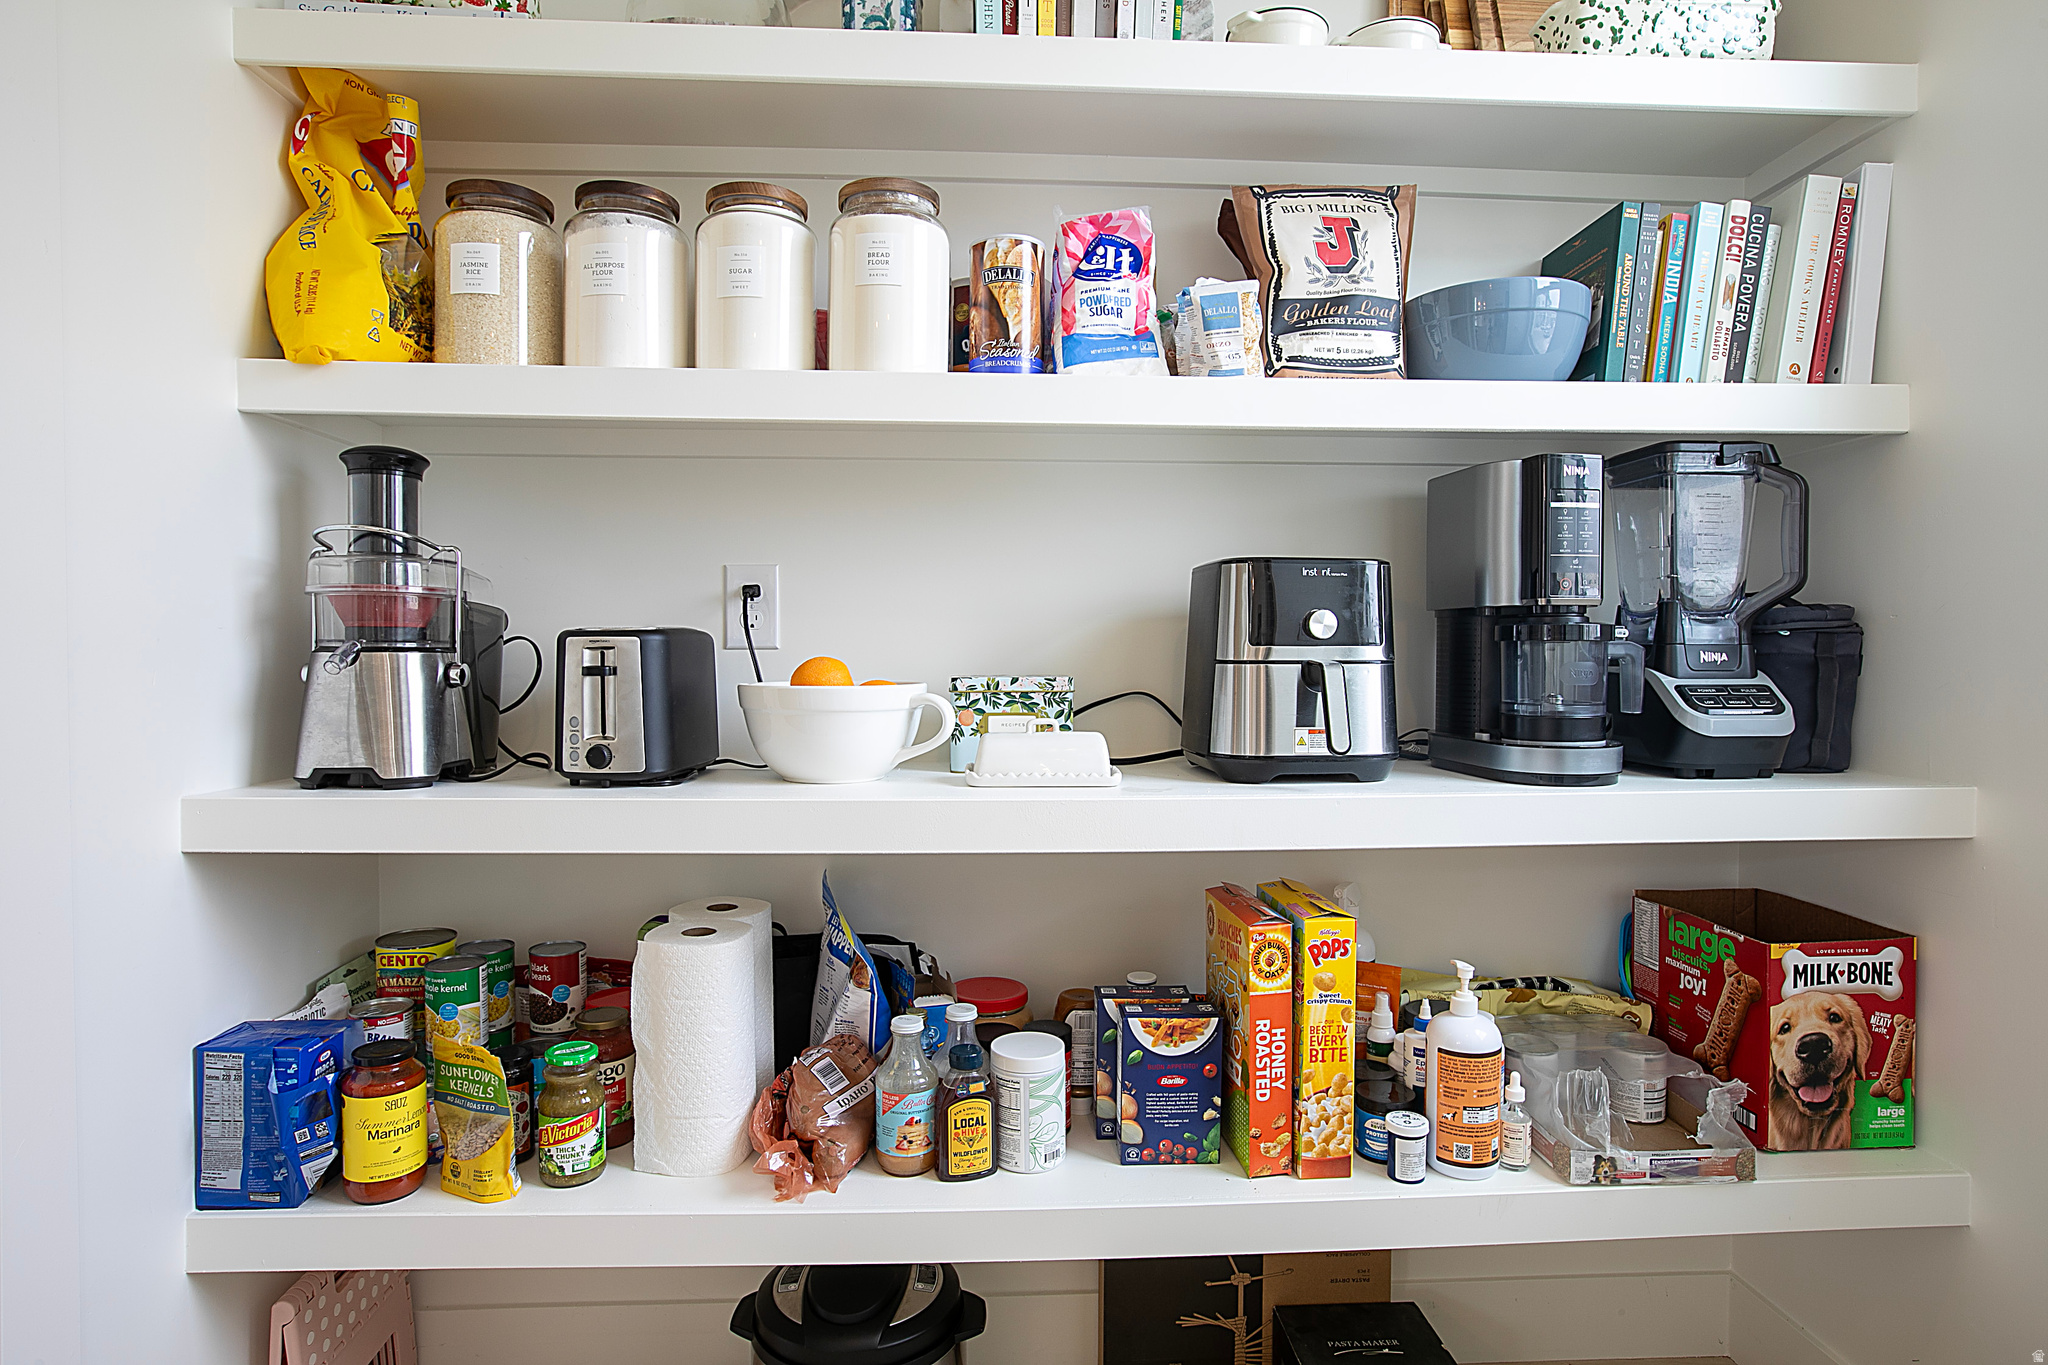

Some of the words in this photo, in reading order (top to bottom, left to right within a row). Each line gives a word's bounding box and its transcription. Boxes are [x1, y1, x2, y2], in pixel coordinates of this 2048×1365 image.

[344, 78, 365, 92] NON
[1280, 204, 1306, 214] BIG
[1308, 205, 1314, 214] J
[1317, 204, 1378, 214] MILLING
[1312, 214, 1360, 274] J
[1725, 215, 1747, 264] DOLCI!
[1744, 213, 1765, 269] CUCINA
[1810, 234, 1820, 254] THE
[1834, 204, 1852, 267] ROMNEY
[1698, 250, 1710, 294] FRENCH
[1760, 239, 1776, 286] BAKING
[1622, 252, 1633, 296] AROUND
[1664, 260, 1682, 304] INDIA
[1803, 258, 1816, 296] COOK'S
[1830, 269, 1838, 296] FAMILY
[1080, 287, 1110, 295] PREMIUM
[1632, 244, 1652, 349] HARVEST
[1089, 304, 1123, 318] SUGAR
[1204, 306, 1238, 317] DELALLO
[1283, 302, 1350, 324] Golden
[1354, 300, 1398, 322] Loaf
[1619, 298, 1628, 318] THE
[1734, 274, 1756, 333] POVERA
[1826, 300, 1834, 324] TABLE
[1306, 318, 1346, 327] BAKERS
[1346, 317, 1378, 326] FLOUR
[1796, 300, 1810, 343] ATELIER
[1616, 318, 1628, 348] TABLE
[1690, 314, 1701, 351] HEART
[1712, 320, 1724, 361] POLIAFITO
[1722, 326, 1730, 358] RENATO
[1748, 306, 1766, 366] HOLIDAYS
[400, 340, 413, 352] NET
[980, 339, 1040, 361] Seasoned
[1336, 346, 1342, 354] 5
[1658, 339, 1668, 374] SODHA
[1563, 464, 1590, 478] NINJA
[1700, 650, 1728, 665] NINJA
[1217, 918, 1242, 946] BUNCHES
[1252, 934, 1265, 942] Post
[1668, 914, 1736, 964] large
[379, 954, 429, 967] CENTO
[1226, 942, 1240, 964] FUN!
[1254, 943, 1267, 966] HONEY
[1268, 943, 1288, 964] BUNCHES
[1308, 938, 1351, 966] POPS
[1672, 946, 1711, 974] biscuits,
[494, 960, 514, 973] kernel
[531, 964, 549, 972] black
[532, 972, 551, 982] beans
[1264, 966, 1285, 978] OATS
[1666, 956, 1701, 977] maximum
[1792, 962, 1840, 989] MILK
[1846, 961, 1894, 986] BONE
[440, 982, 468, 992] kernel
[1310, 1025, 1332, 1034] BEST
[1336, 1025, 1348, 1034] IN
[1870, 1014, 1892, 1028] MEATY
[1872, 1025, 1888, 1034] Taste
[1309, 1034, 1348, 1046] EVERY
[1256, 1019, 1270, 1102] ROASTED
[1272, 1028, 1286, 1090] HONEY
[1309, 1047, 1348, 1063] BITE
[315, 1062, 329, 1076] mac
[440, 1064, 499, 1087] SUNFLOWER
[450, 1078, 494, 1098] KERNELS
[837, 1084, 869, 1108] IDAHO
[384, 1096, 408, 1112] SAUZ
[454, 1098, 464, 1106] SALT
[468, 1102, 496, 1112] ROASTED
[1878, 1106, 1905, 1118] large
[354, 1116, 406, 1130] Summer
[406, 1104, 426, 1122] Lemon
[954, 1116, 986, 1130] LOCAL
[367, 1120, 420, 1140] Marinara
[541, 1128, 548, 1145] La
[547, 1115, 594, 1143] Victoria
[962, 1127, 980, 1136] HIVE
[556, 1150, 586, 1160] CHUNKY
[952, 1147, 988, 1158] WILDFLOWER
[574, 1162, 590, 1170] MILD
